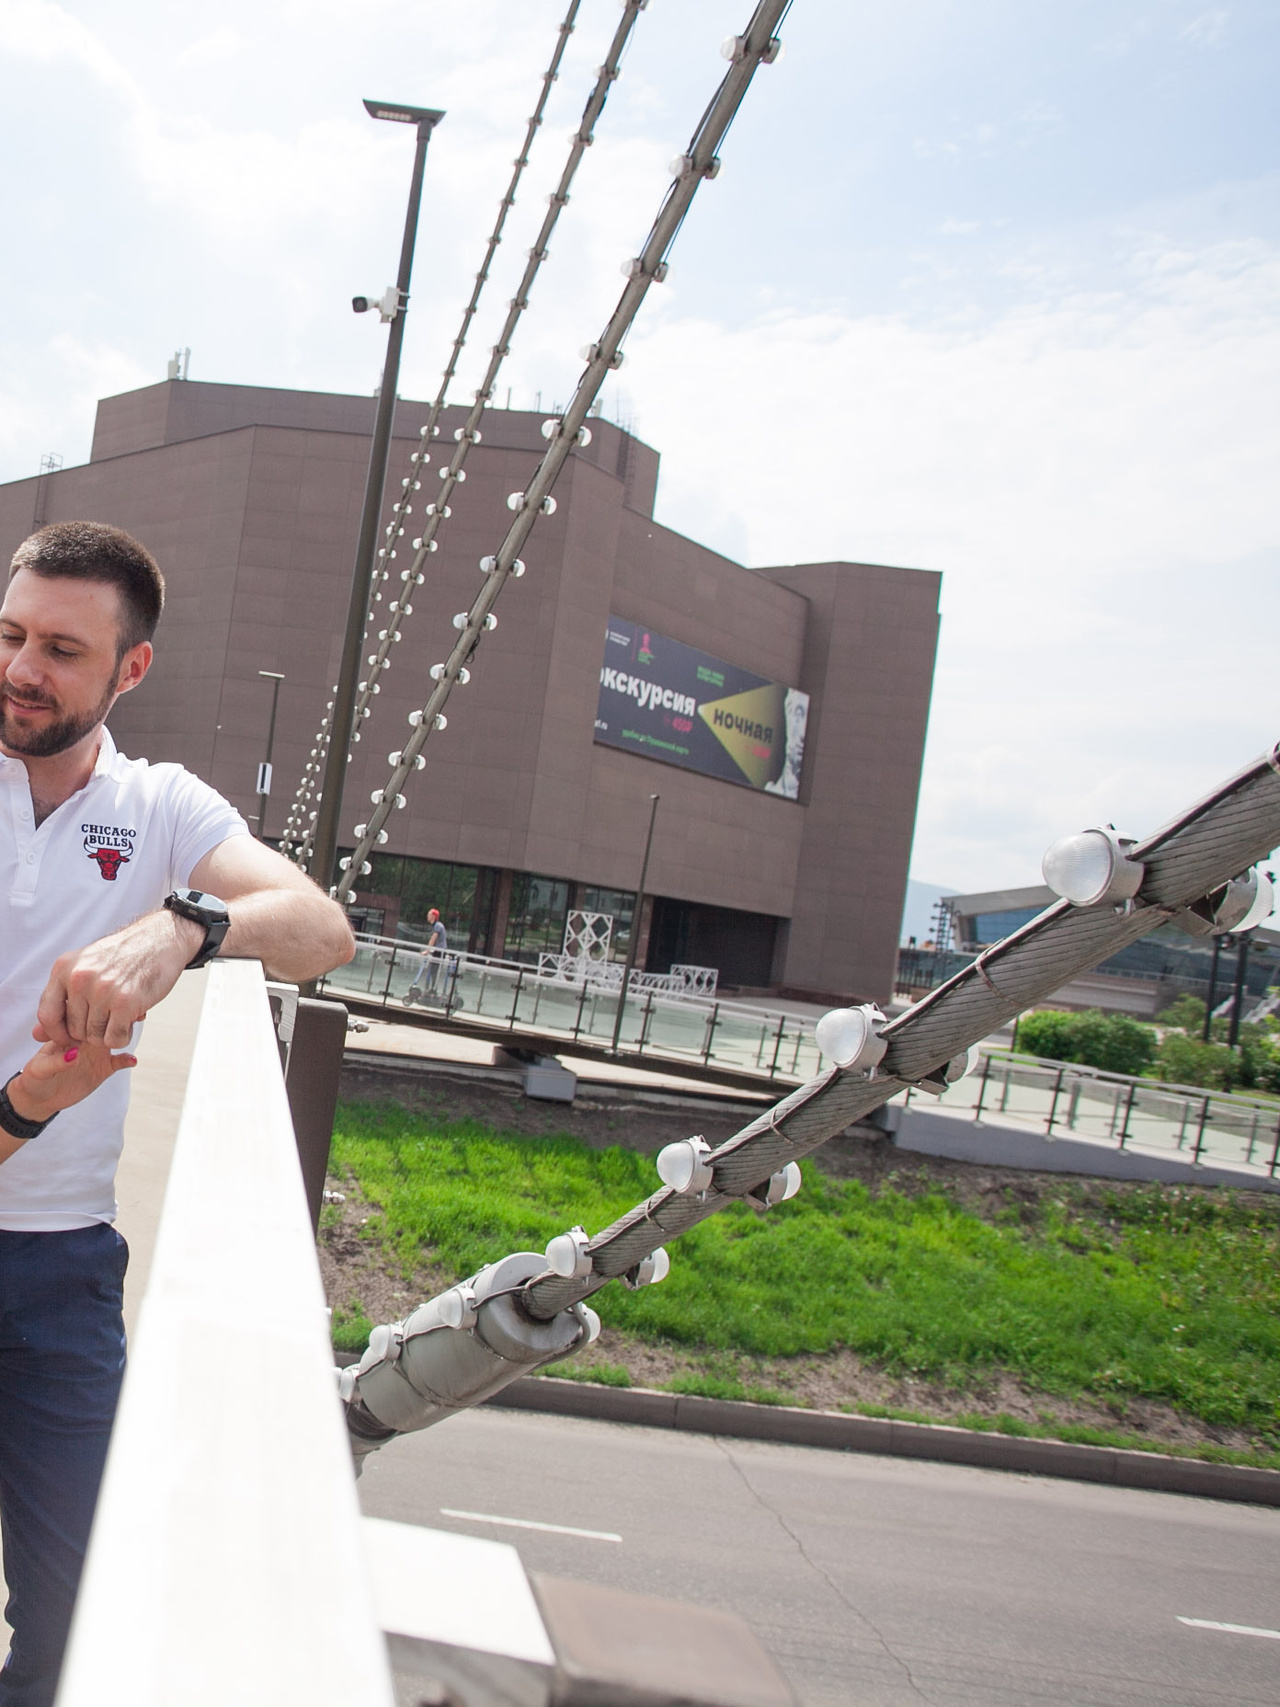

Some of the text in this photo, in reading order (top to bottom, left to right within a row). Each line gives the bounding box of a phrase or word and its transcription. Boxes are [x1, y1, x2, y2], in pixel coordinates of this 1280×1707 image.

[713, 708, 773, 743] ночная
[81, 823, 136, 838] CHICAGO
[89, 835, 128, 847] BULLS
